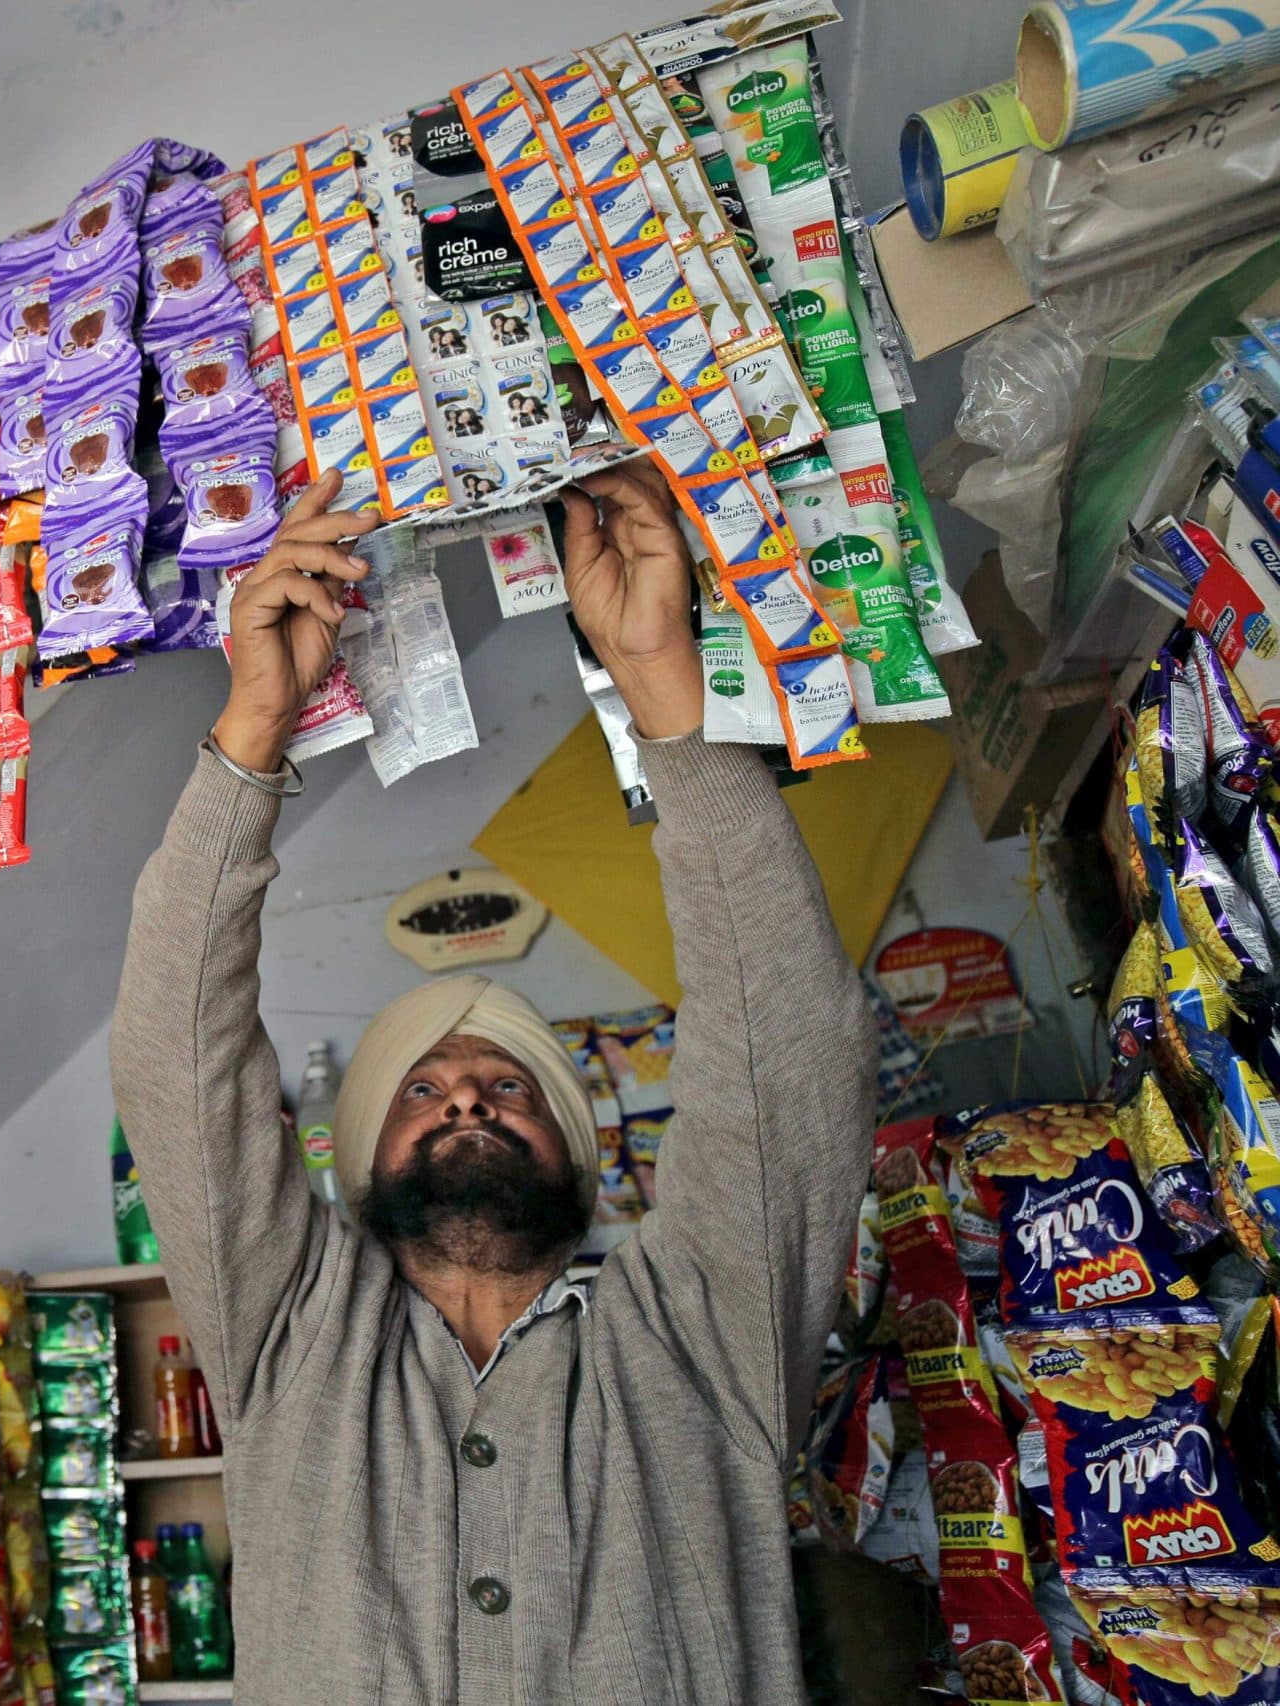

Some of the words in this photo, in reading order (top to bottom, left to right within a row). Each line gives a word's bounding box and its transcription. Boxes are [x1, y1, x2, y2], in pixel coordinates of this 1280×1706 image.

[662, 57, 703, 75] SHAMPOO
[729, 78, 784, 107] Dettol
[765, 97, 807, 117] POWDER
[767, 113, 779, 123] TO
[780, 105, 812, 120] LIQUID
[426, 122, 463, 139] rich
[791, 159, 822, 174] ORIGINAL
[458, 200, 497, 214] exper
[438, 237, 477, 257] rich
[818, 233, 837, 250] 10
[439, 247, 508, 271] crème
[805, 329, 849, 345] POWDER
[806, 342, 820, 352] TO
[822, 335, 857, 350] LIQUID
[495, 354, 543, 370] CLINIC
[732, 357, 773, 383] Dove
[836, 402, 870, 414] ORIGINAL
[855, 406, 873, 415] PINE
[869, 478, 889, 495] 10
[810, 548, 880, 576] Dettol
[513, 582, 556, 601] Dove
[861, 586, 907, 599] POWDER
[862, 598, 879, 608] TO
[796, 690, 849, 705] shoulders
[1016, 1178, 1144, 1271] Curls
[1066, 1269, 1142, 1307] CRAX
[1085, 1424, 1218, 1513] Curls
[1135, 1524, 1221, 1561] CRAX
